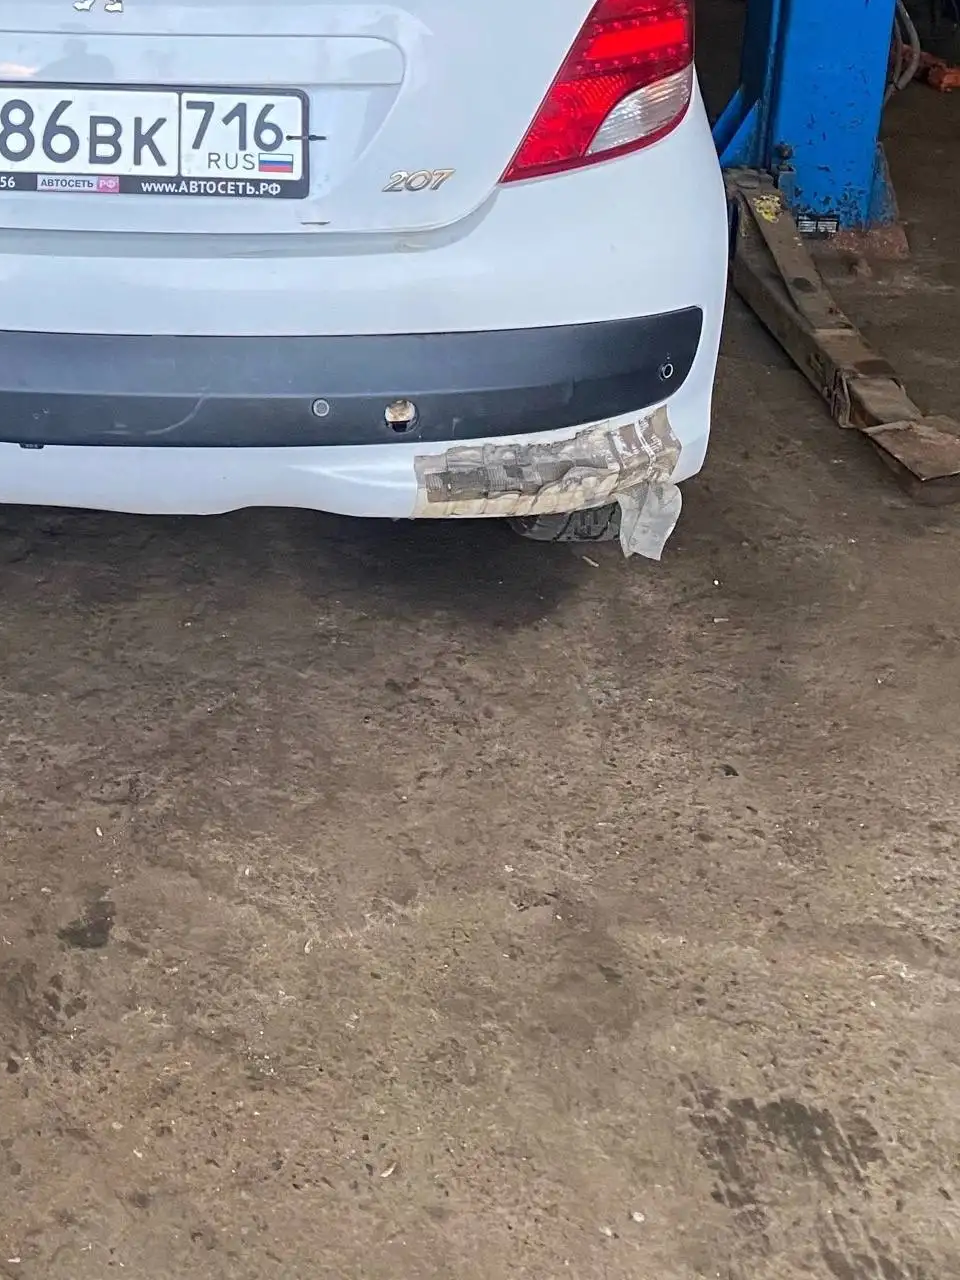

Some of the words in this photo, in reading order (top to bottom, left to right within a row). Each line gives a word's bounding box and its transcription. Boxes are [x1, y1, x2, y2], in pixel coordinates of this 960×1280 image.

[186, 101, 284, 152] 716
[207, 152, 256, 170] RUS
[141, 180, 282, 196] www.АВТОСЕТЬ.РФ
[381, 168, 457, 192] 207
